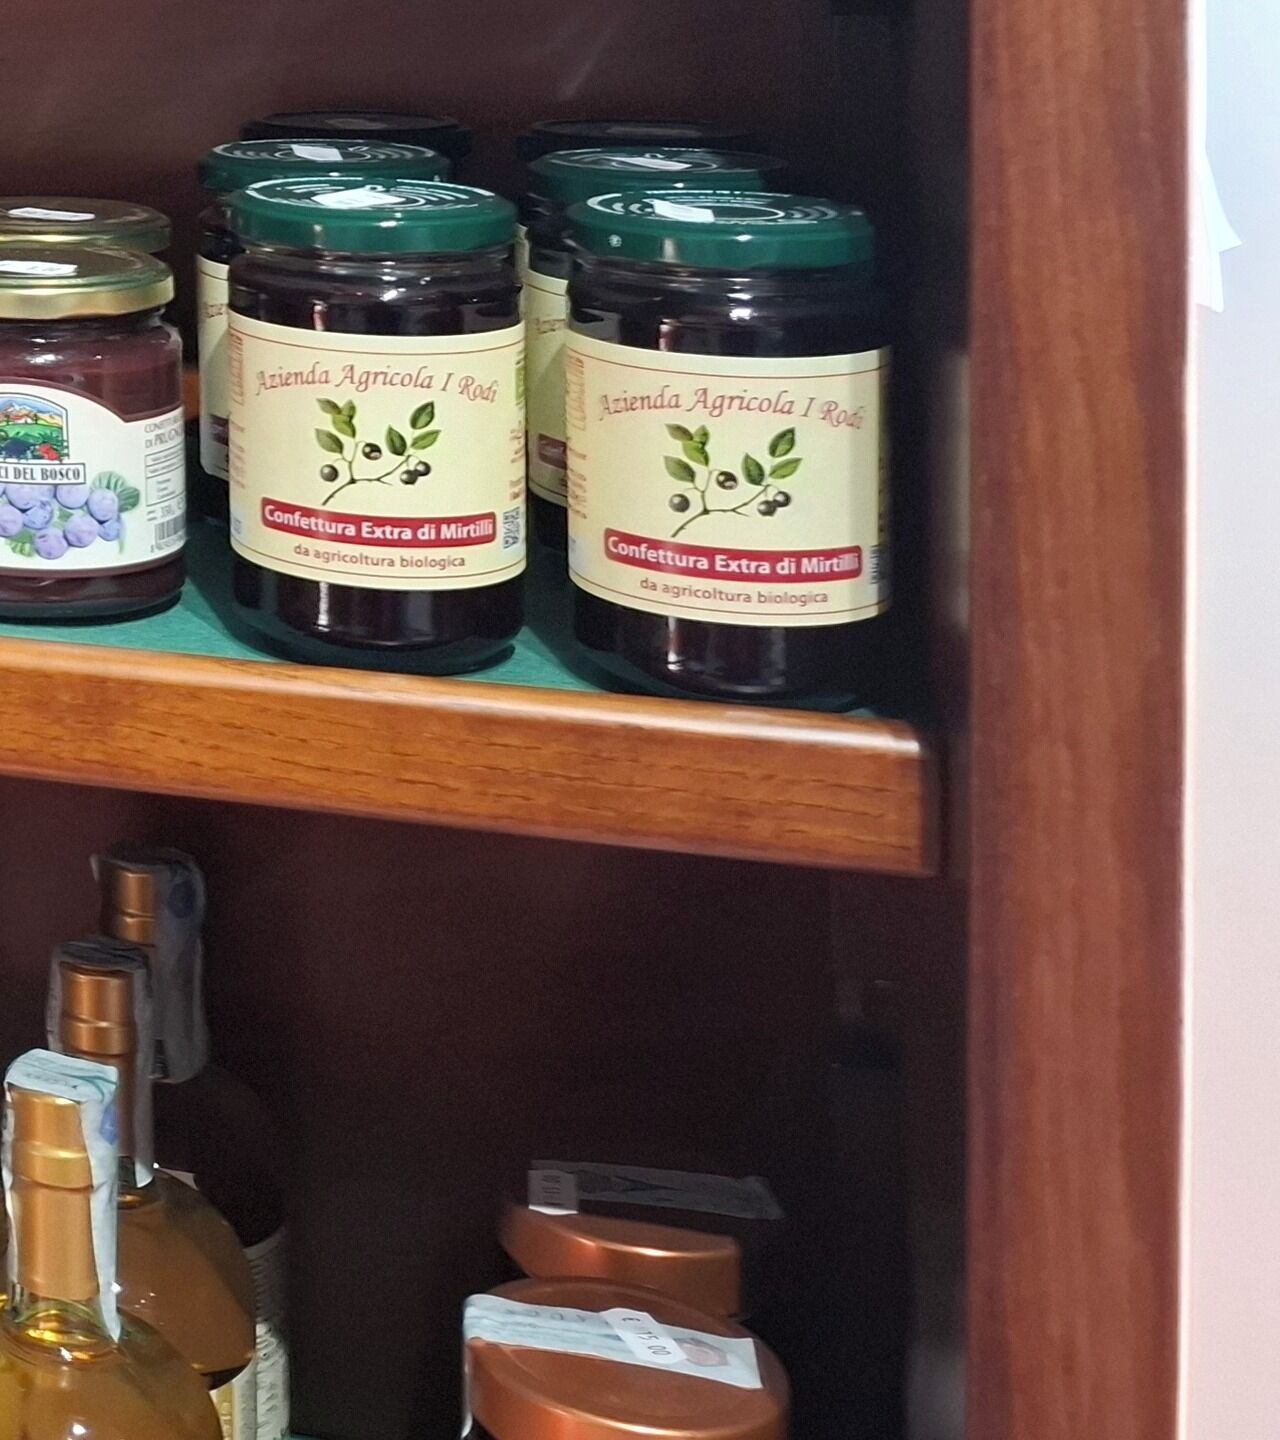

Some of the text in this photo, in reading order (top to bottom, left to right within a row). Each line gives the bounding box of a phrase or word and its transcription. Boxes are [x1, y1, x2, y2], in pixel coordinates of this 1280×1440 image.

[254, 361, 499, 404] Azienda Agricola Rodi
[598, 384, 867, 431] Azienda Agricola Rodi
[13, 466, 36, 480] DEL
[40, 467, 81, 481] BOSCO
[263, 505, 494, 541] Confettura Extra di Mirtilli
[293, 543, 466, 571] da agricoltura biologica
[607, 534, 860, 576] Confettura Extra di Mirtilli
[639, 576, 830, 608] da agricoltura biologica
[637, 1329, 672, 1357] 15.00
